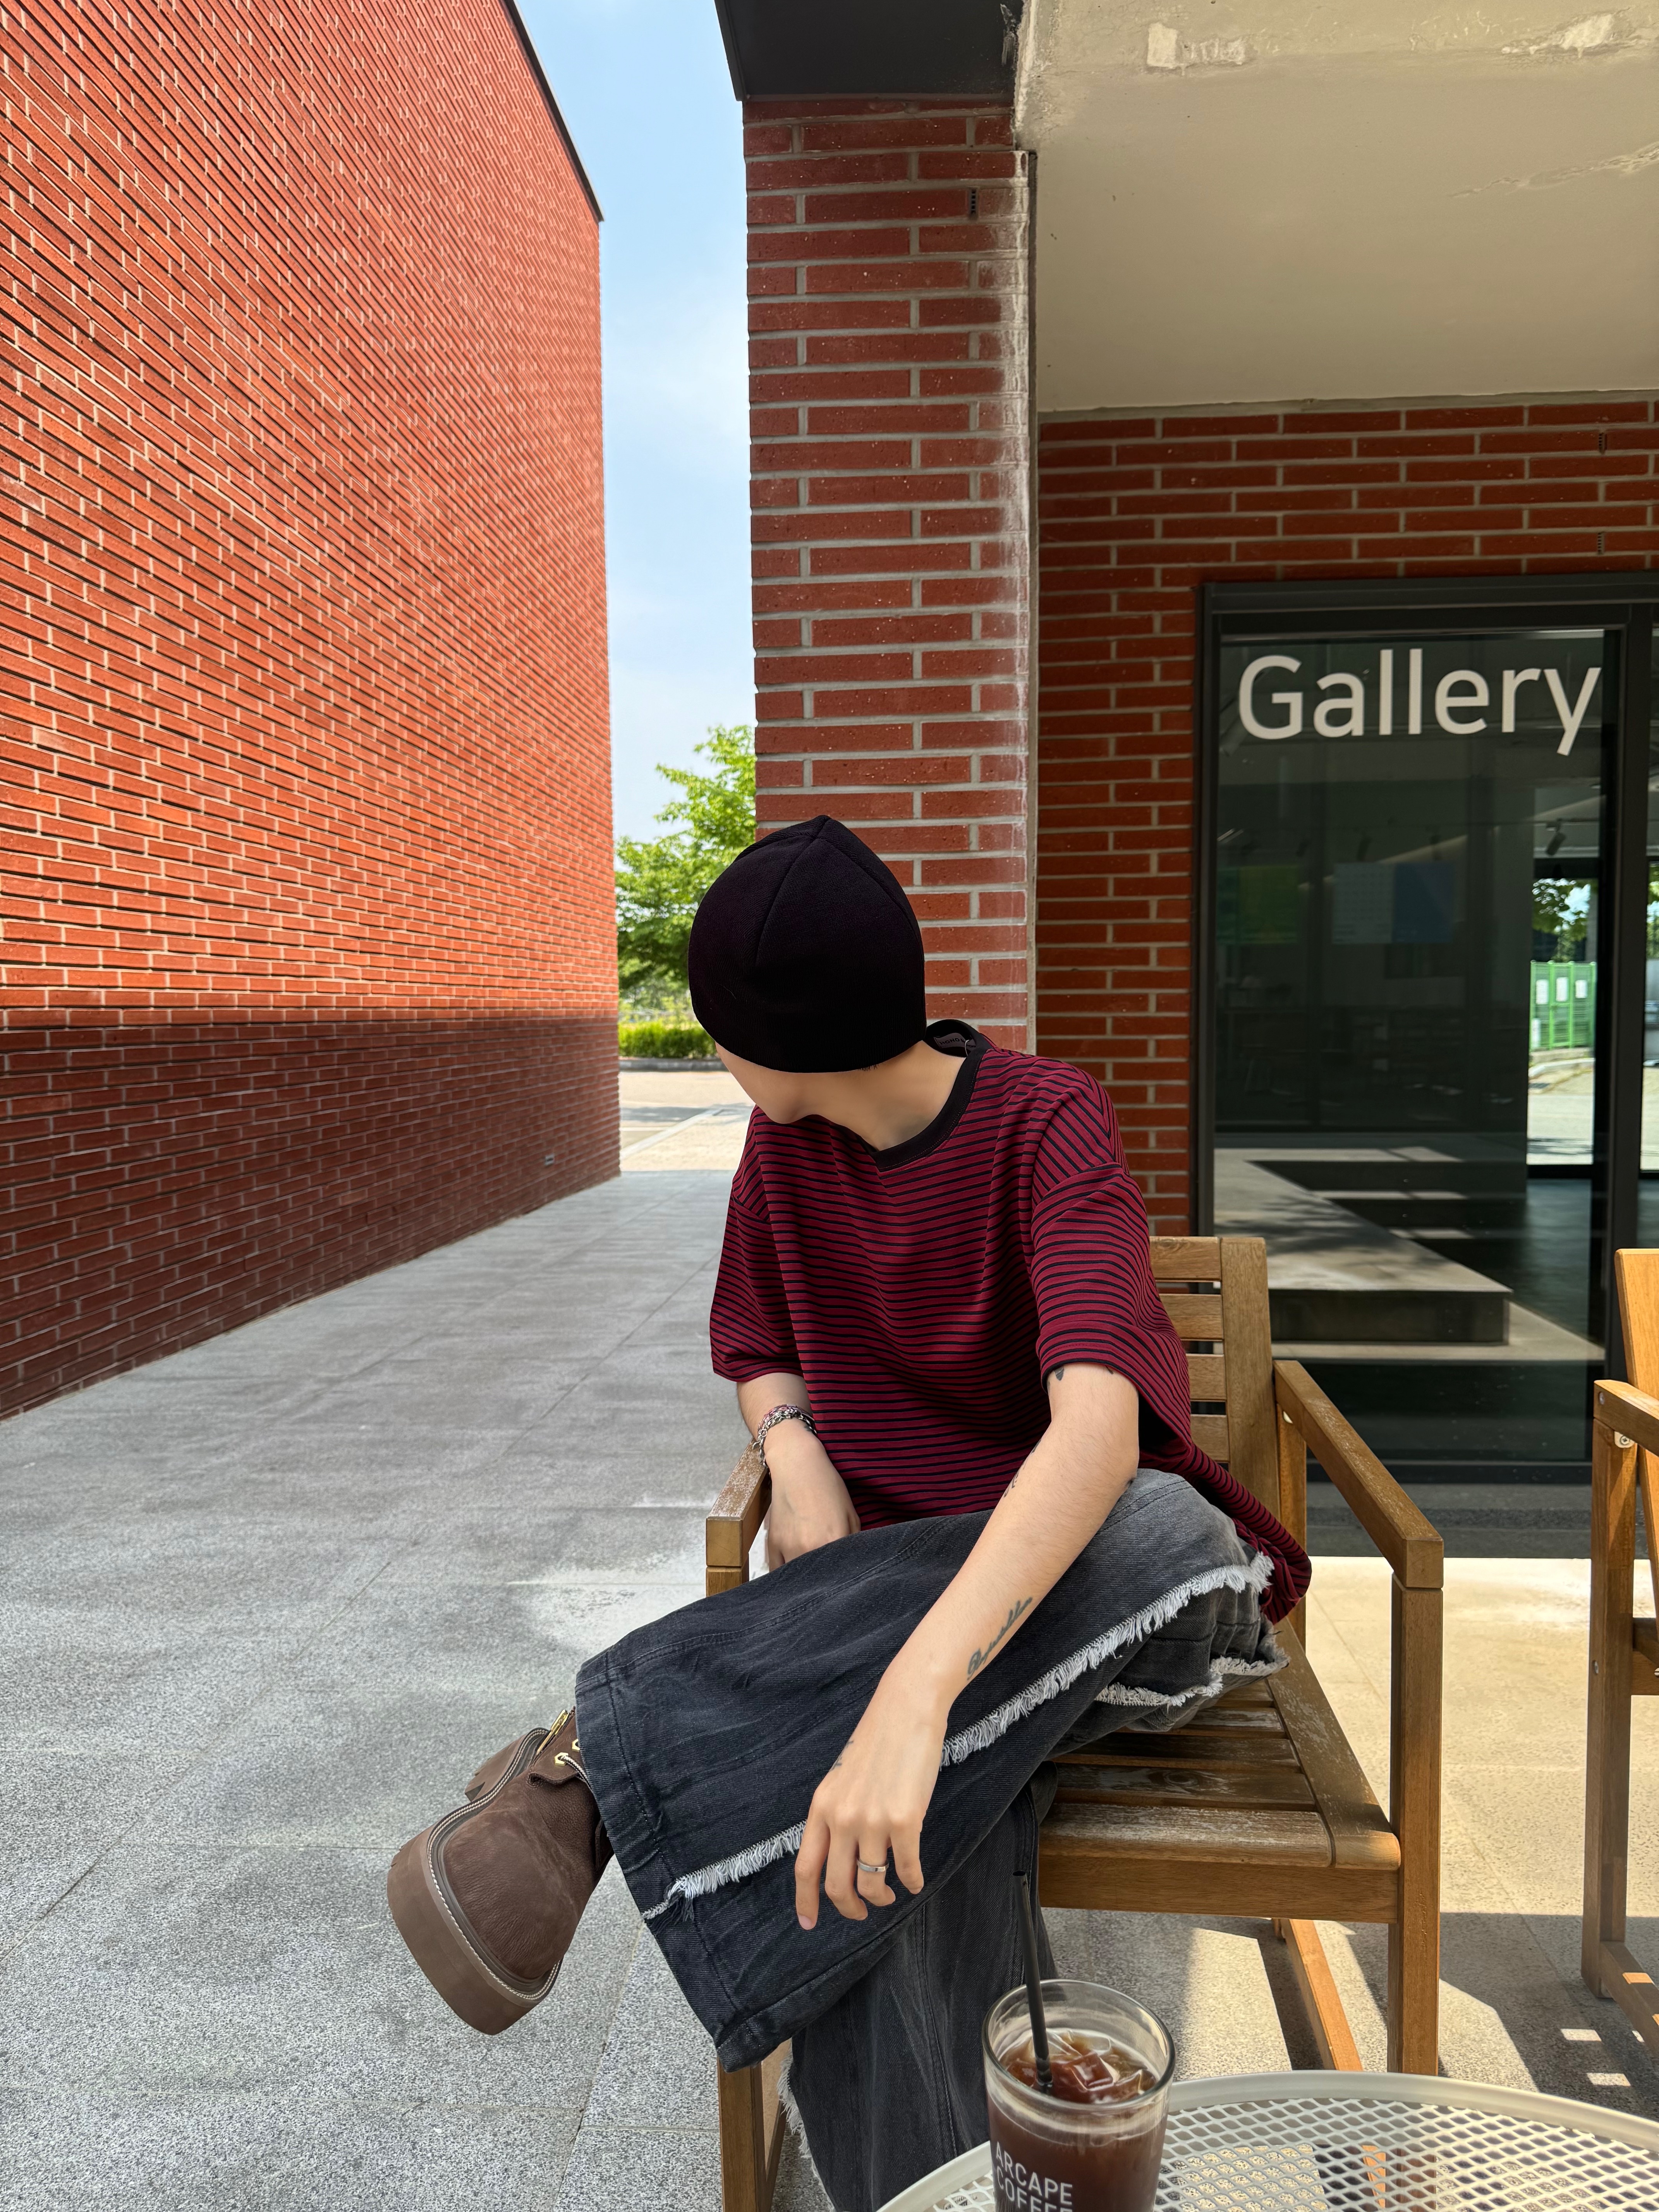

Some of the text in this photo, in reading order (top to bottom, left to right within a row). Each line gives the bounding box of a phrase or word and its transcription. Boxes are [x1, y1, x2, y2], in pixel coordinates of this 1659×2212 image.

[1239, 648, 1602, 756] Gallery
[996, 2141, 1072, 2205] ARCAPE
[997, 2166, 1072, 2212] COFF
